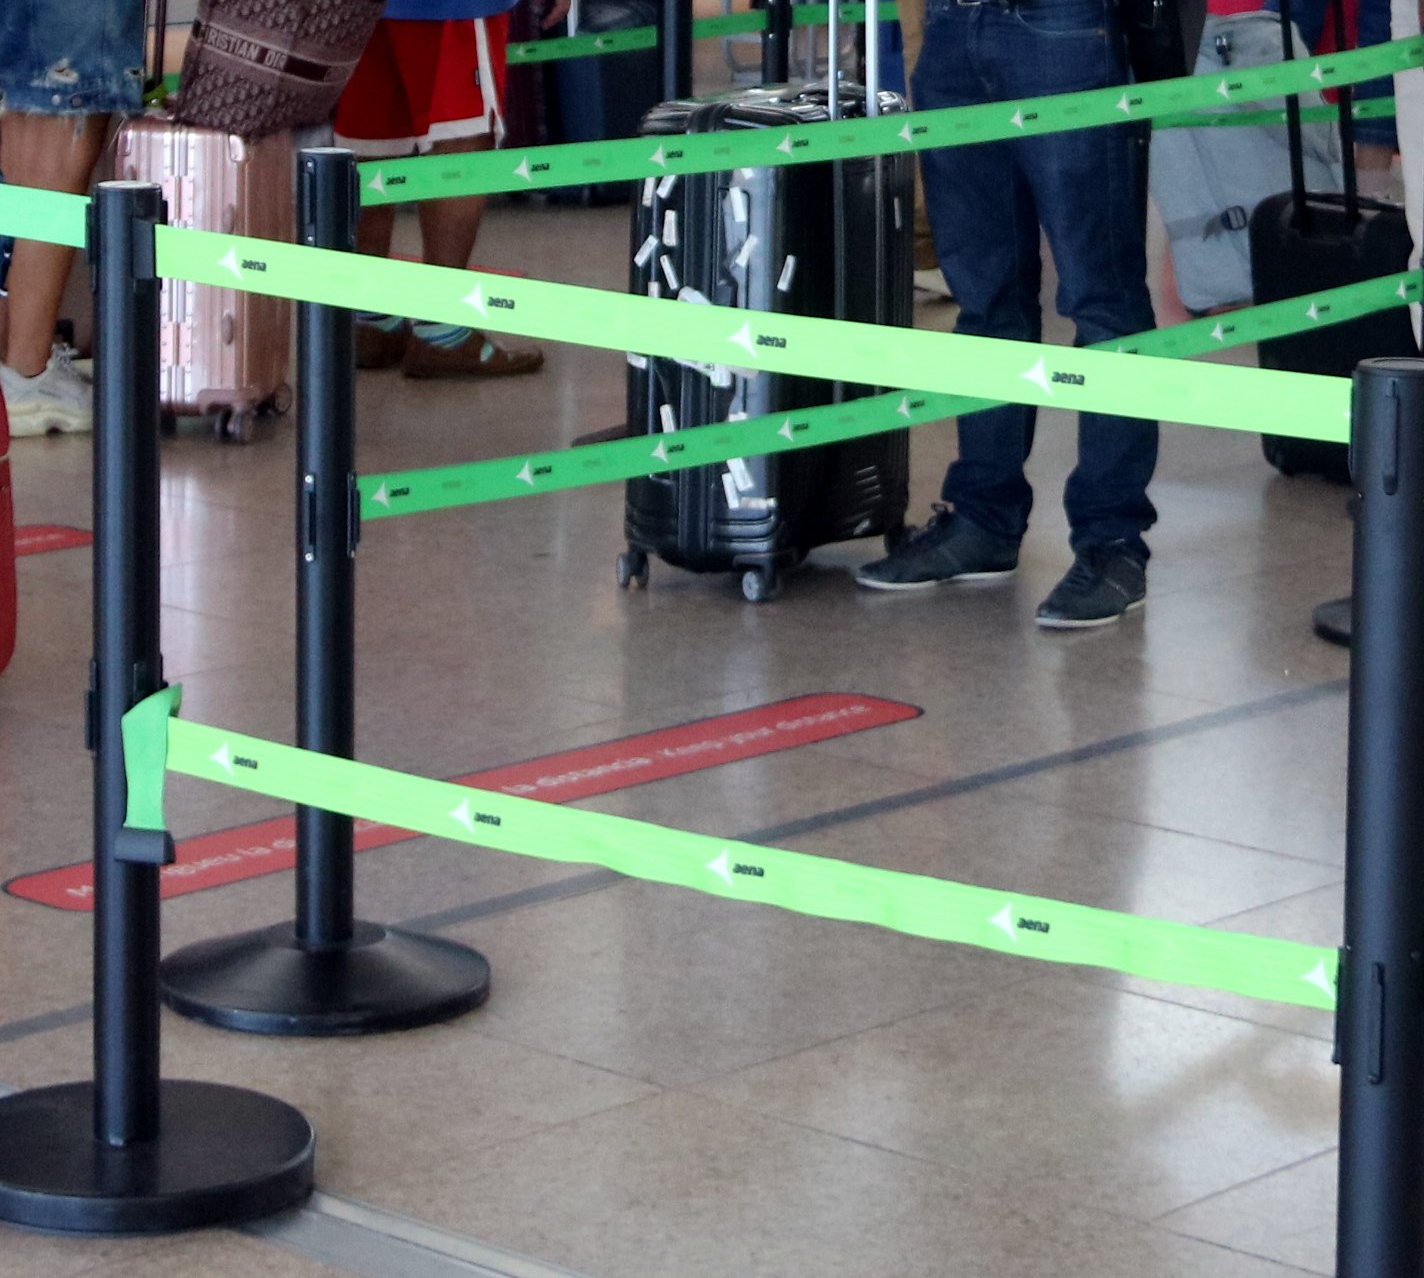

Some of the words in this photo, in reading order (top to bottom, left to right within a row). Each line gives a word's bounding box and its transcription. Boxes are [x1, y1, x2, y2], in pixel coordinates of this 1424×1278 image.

[240, 259, 267, 272] aena
[486, 296, 516, 310] aena
[755, 334, 787, 349] aena
[1050, 371, 1086, 386] aena
[232, 756, 258, 770] aena
[473, 812, 501, 827] aena
[731, 863, 765, 878] aena
[1016, 918, 1050, 934] aena
